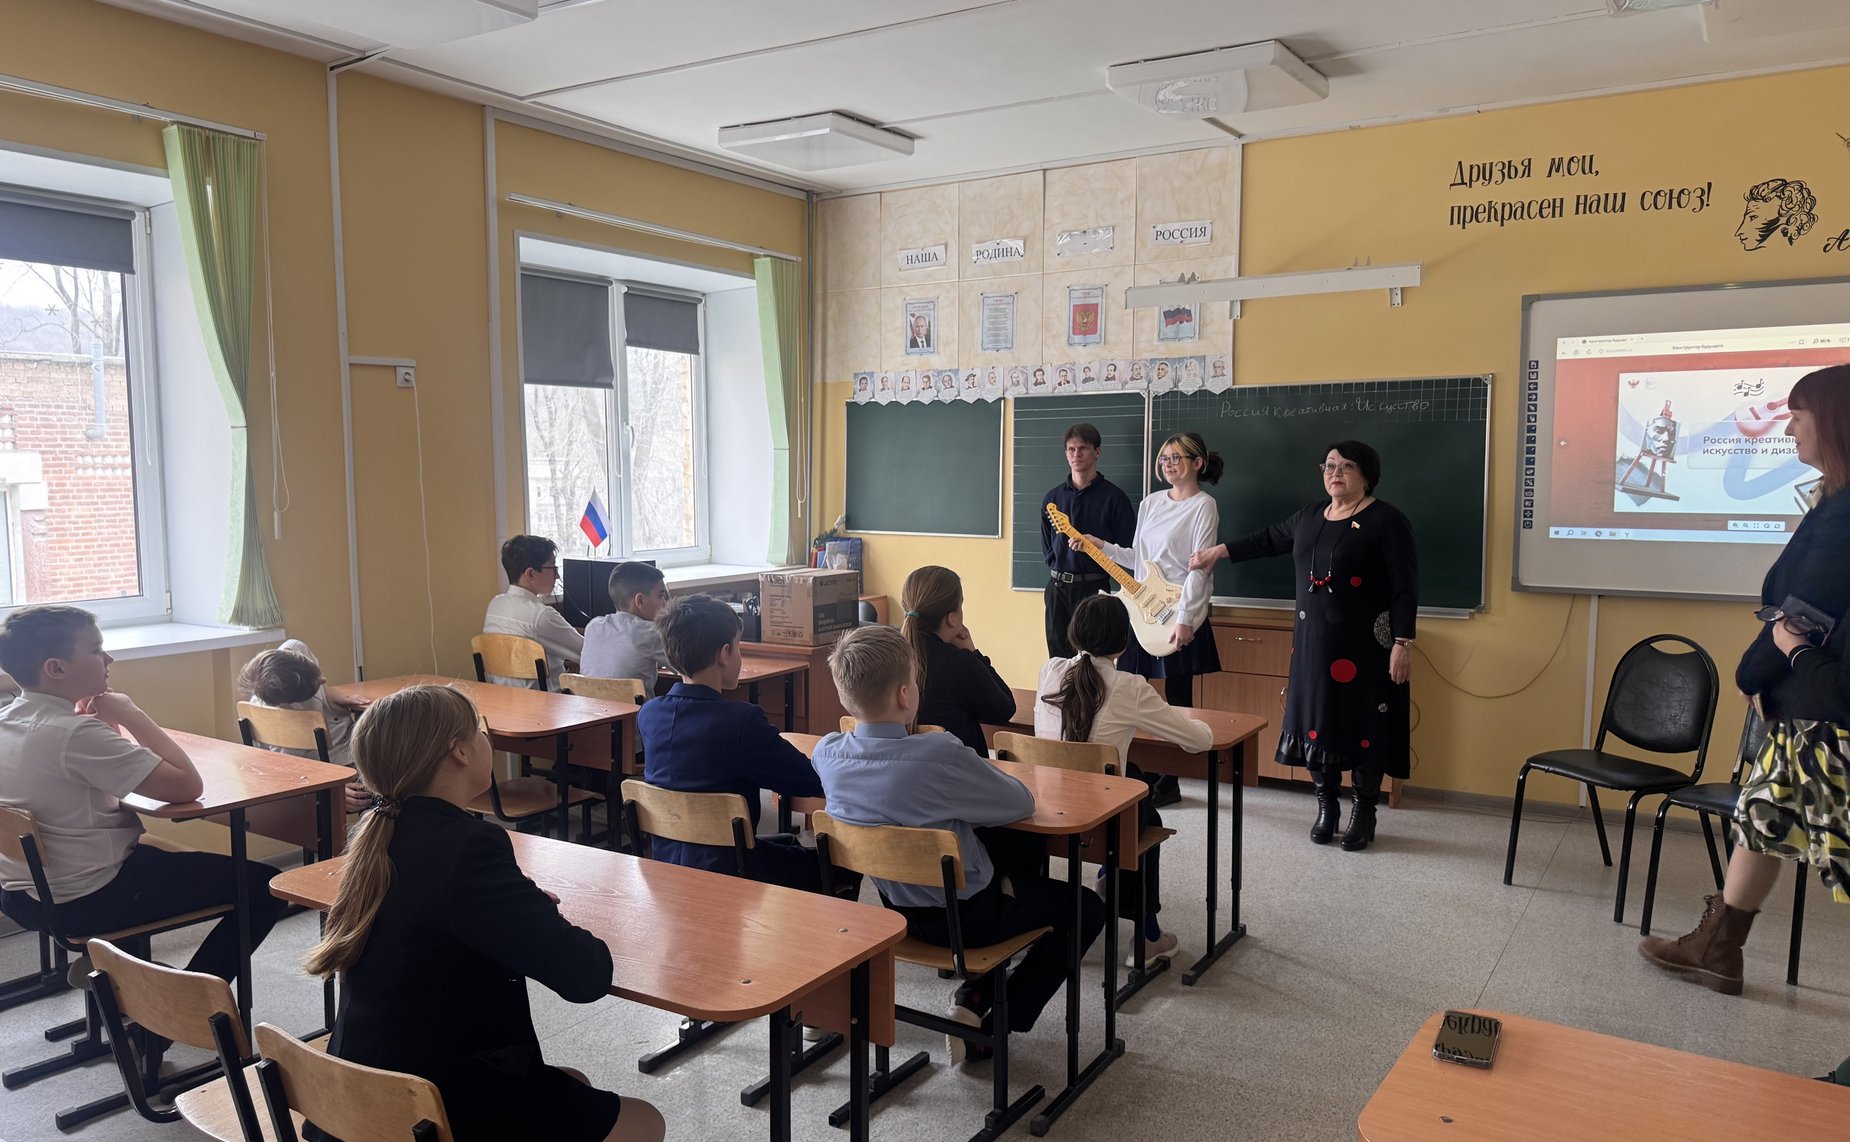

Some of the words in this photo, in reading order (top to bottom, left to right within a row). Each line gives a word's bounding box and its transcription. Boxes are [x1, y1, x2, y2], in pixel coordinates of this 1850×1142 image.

[1450, 157, 1532, 190] Друзья
[1546, 153, 1600, 178] мои,
[1449, 197, 1564, 230] прекрасен
[1574, 191, 1627, 215] наш
[1640, 181, 1713, 213] союз!
[906, 251, 939, 265] НАША
[975, 246, 1021, 261] РОДИНА
[1155, 226, 1207, 241] РОССИЯ
[1220, 401, 1270, 418] Россия
[1702, 447, 1758, 456] искусство
[1761, 447, 1768, 455] и
[1703, 436, 1741, 444] Россия
